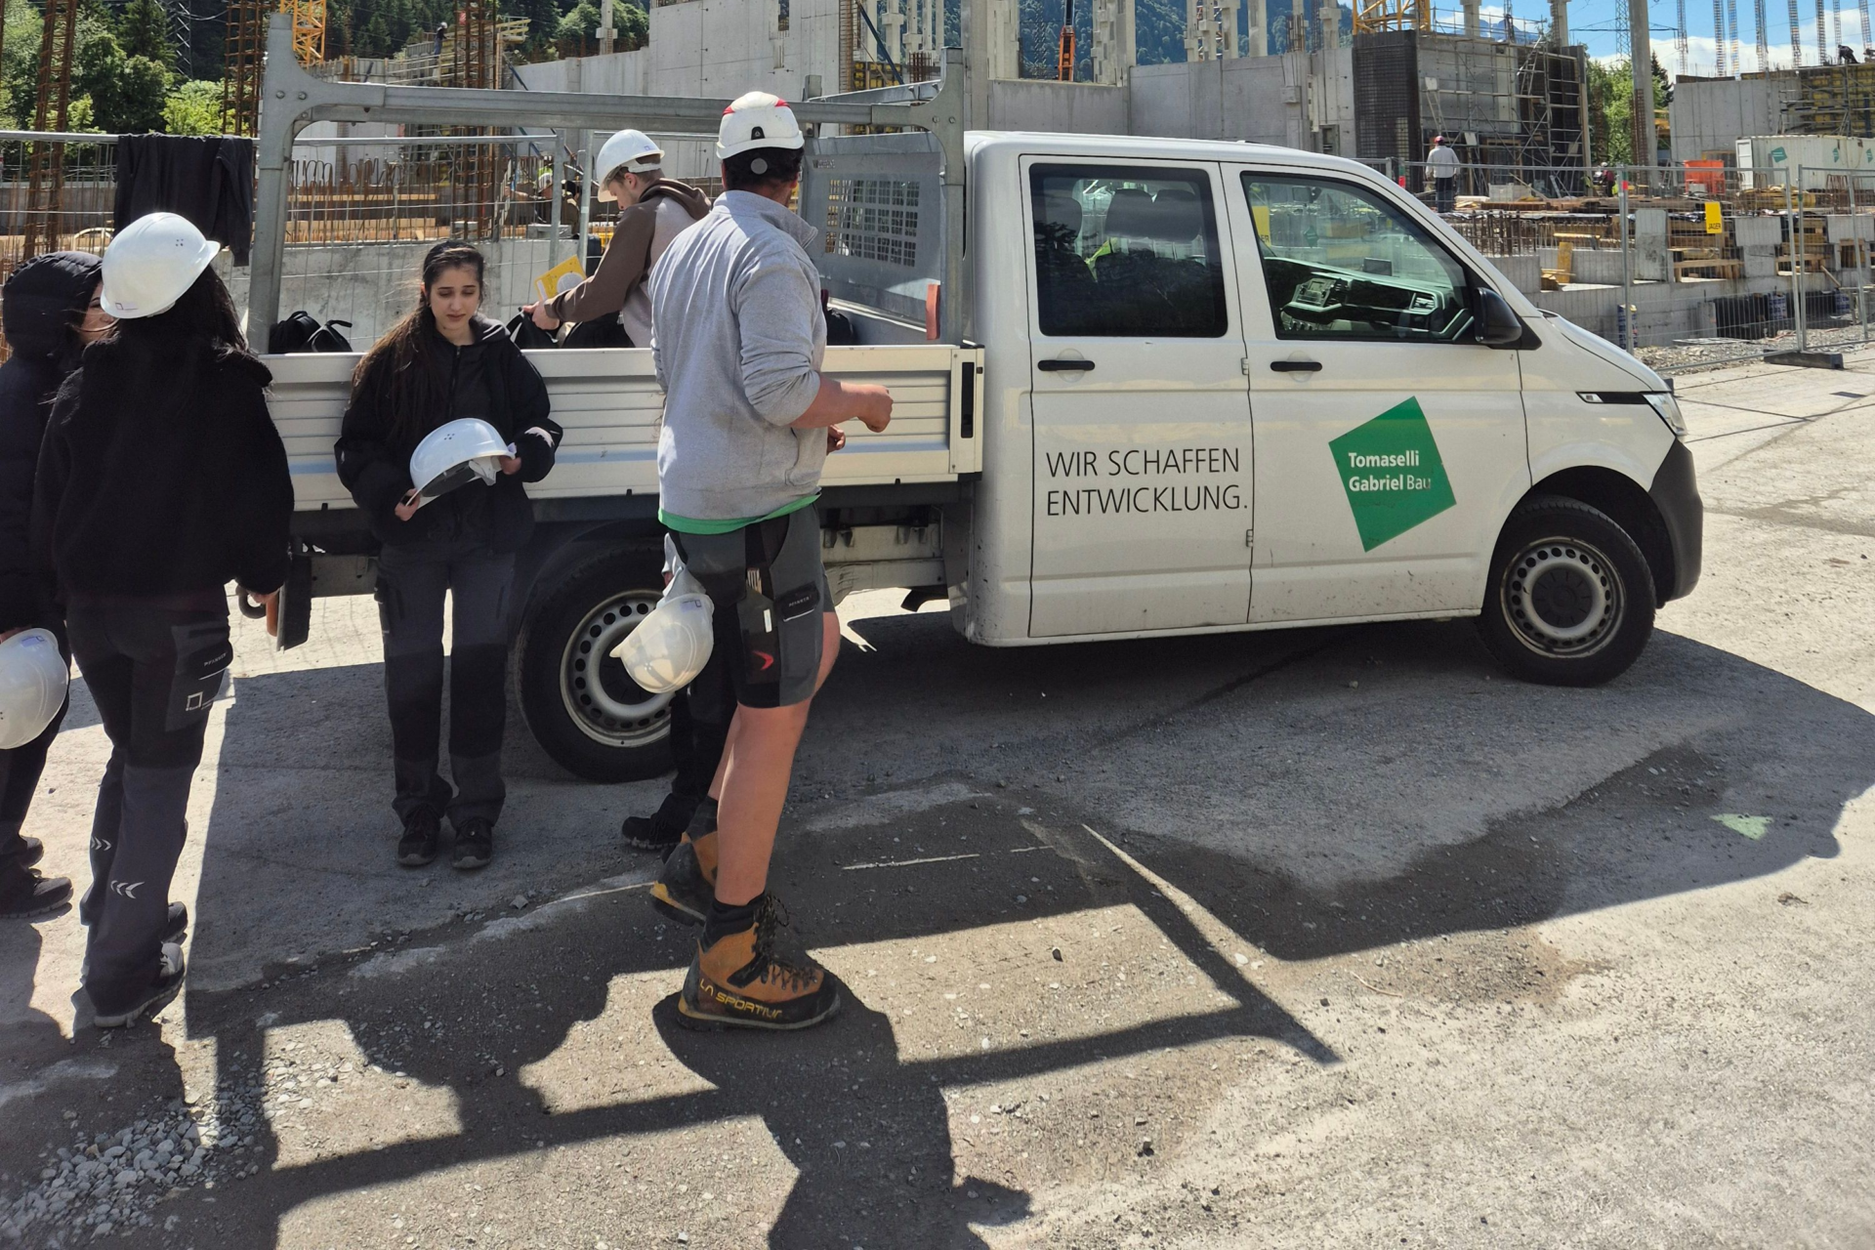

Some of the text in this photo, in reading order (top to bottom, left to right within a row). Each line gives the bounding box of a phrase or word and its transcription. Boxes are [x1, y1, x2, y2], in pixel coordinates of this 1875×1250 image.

[1046, 448, 1239, 478] WIR SCHAFFEN
[1348, 450, 1419, 468] Tomaselli
[1349, 474, 1431, 492] Gabriel Bau
[1047, 485, 1248, 516] ENTWICKLUNG.
[700, 978, 714, 997] LA
